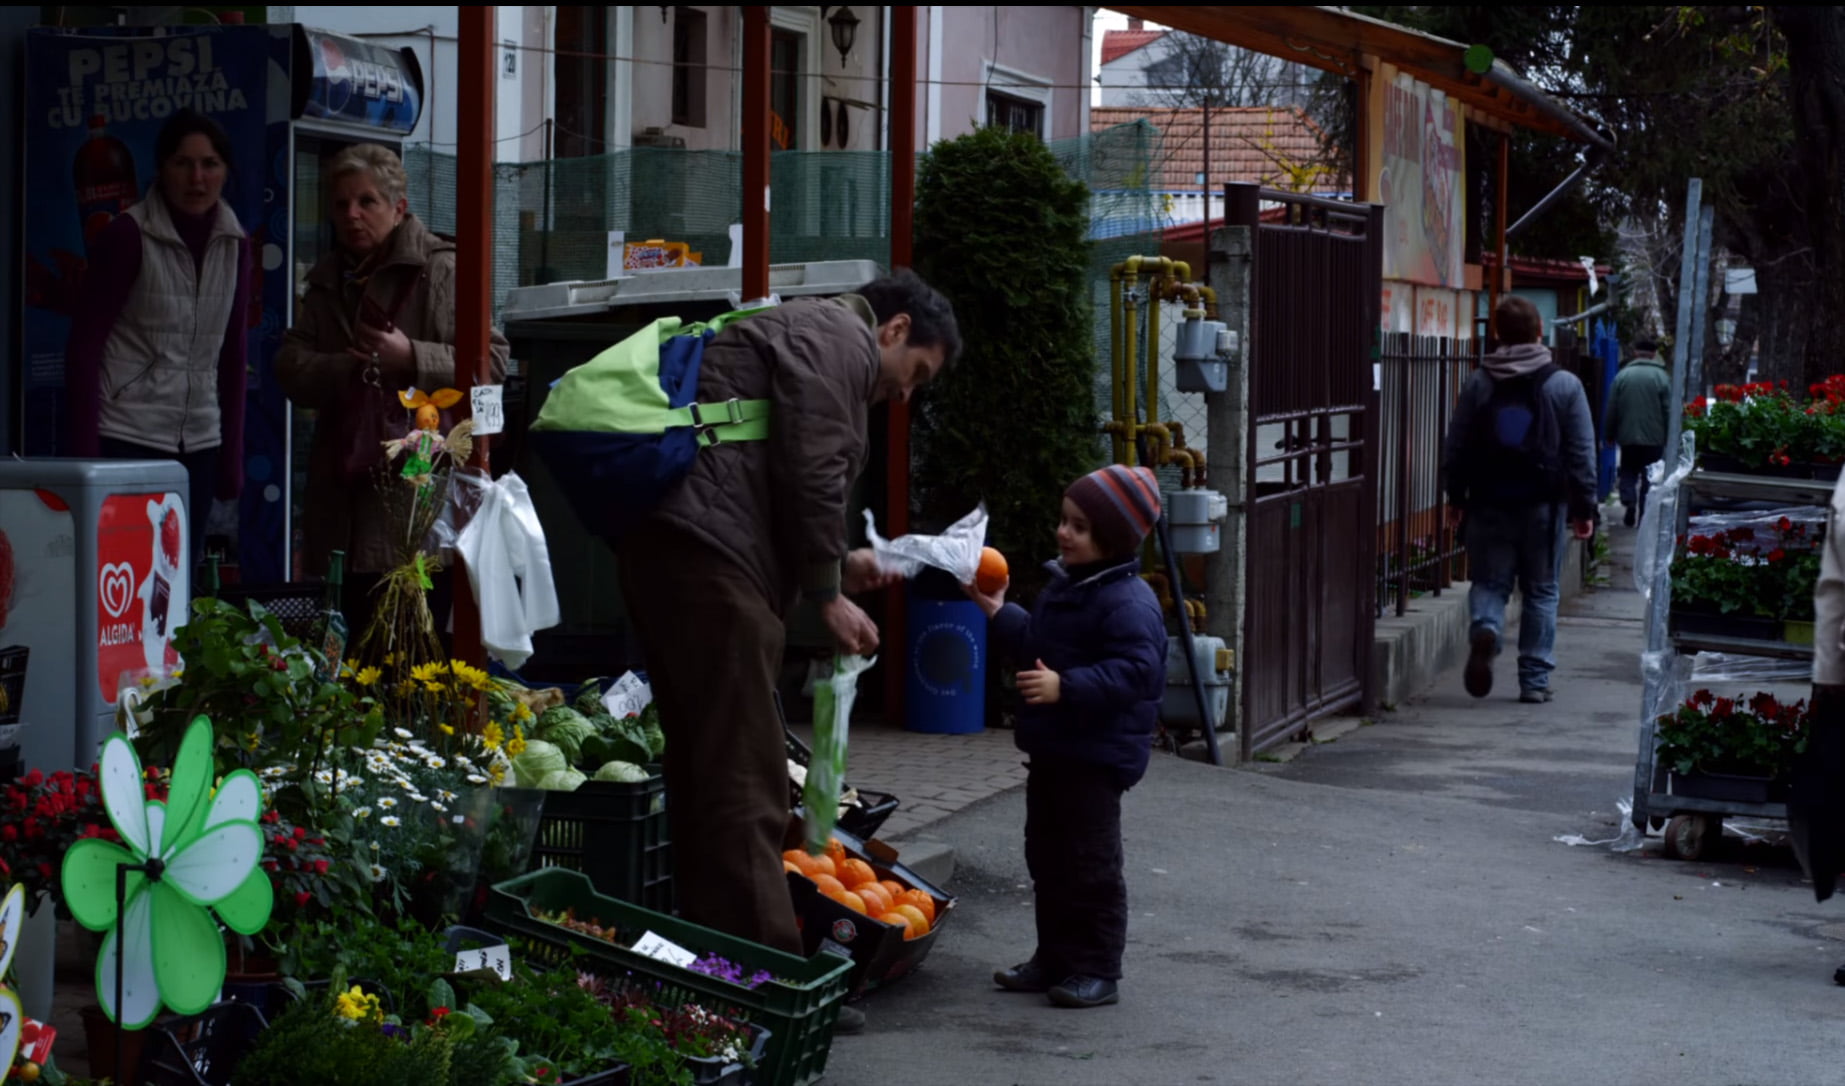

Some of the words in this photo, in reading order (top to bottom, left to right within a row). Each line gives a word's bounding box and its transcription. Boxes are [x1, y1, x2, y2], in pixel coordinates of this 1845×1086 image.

[68, 35, 213, 87] PEPSI
[57, 86, 84, 106] TE
[94, 66, 230, 101] PREMIAZĂ
[351, 59, 404, 105] PEPSI
[47, 102, 83, 128] CU
[94, 87, 249, 123] BUCOVINA
[99, 623, 134, 647] ALGIDA
